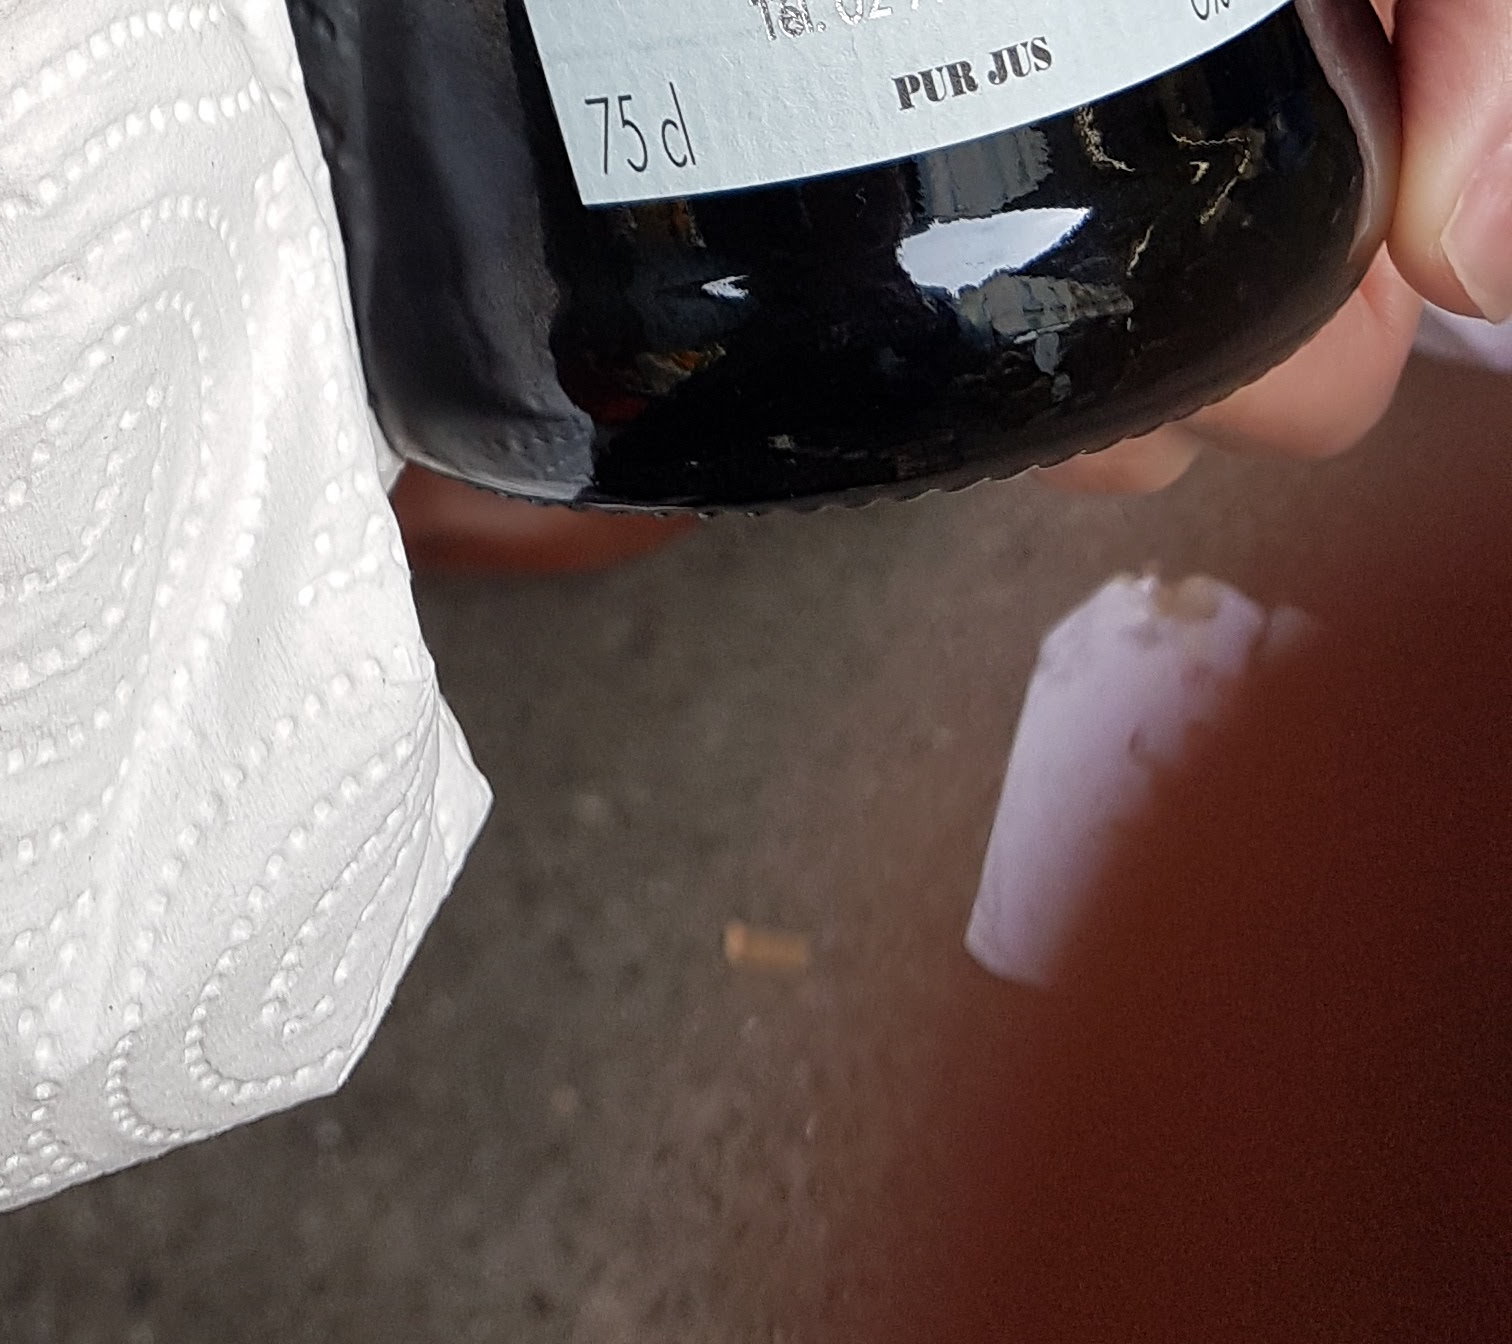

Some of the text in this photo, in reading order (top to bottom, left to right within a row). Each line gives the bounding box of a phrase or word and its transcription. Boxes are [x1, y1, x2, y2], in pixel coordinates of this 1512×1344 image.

[891, 36, 1053, 112] PUR JUS
[584, 82, 696, 176] 75 cl
